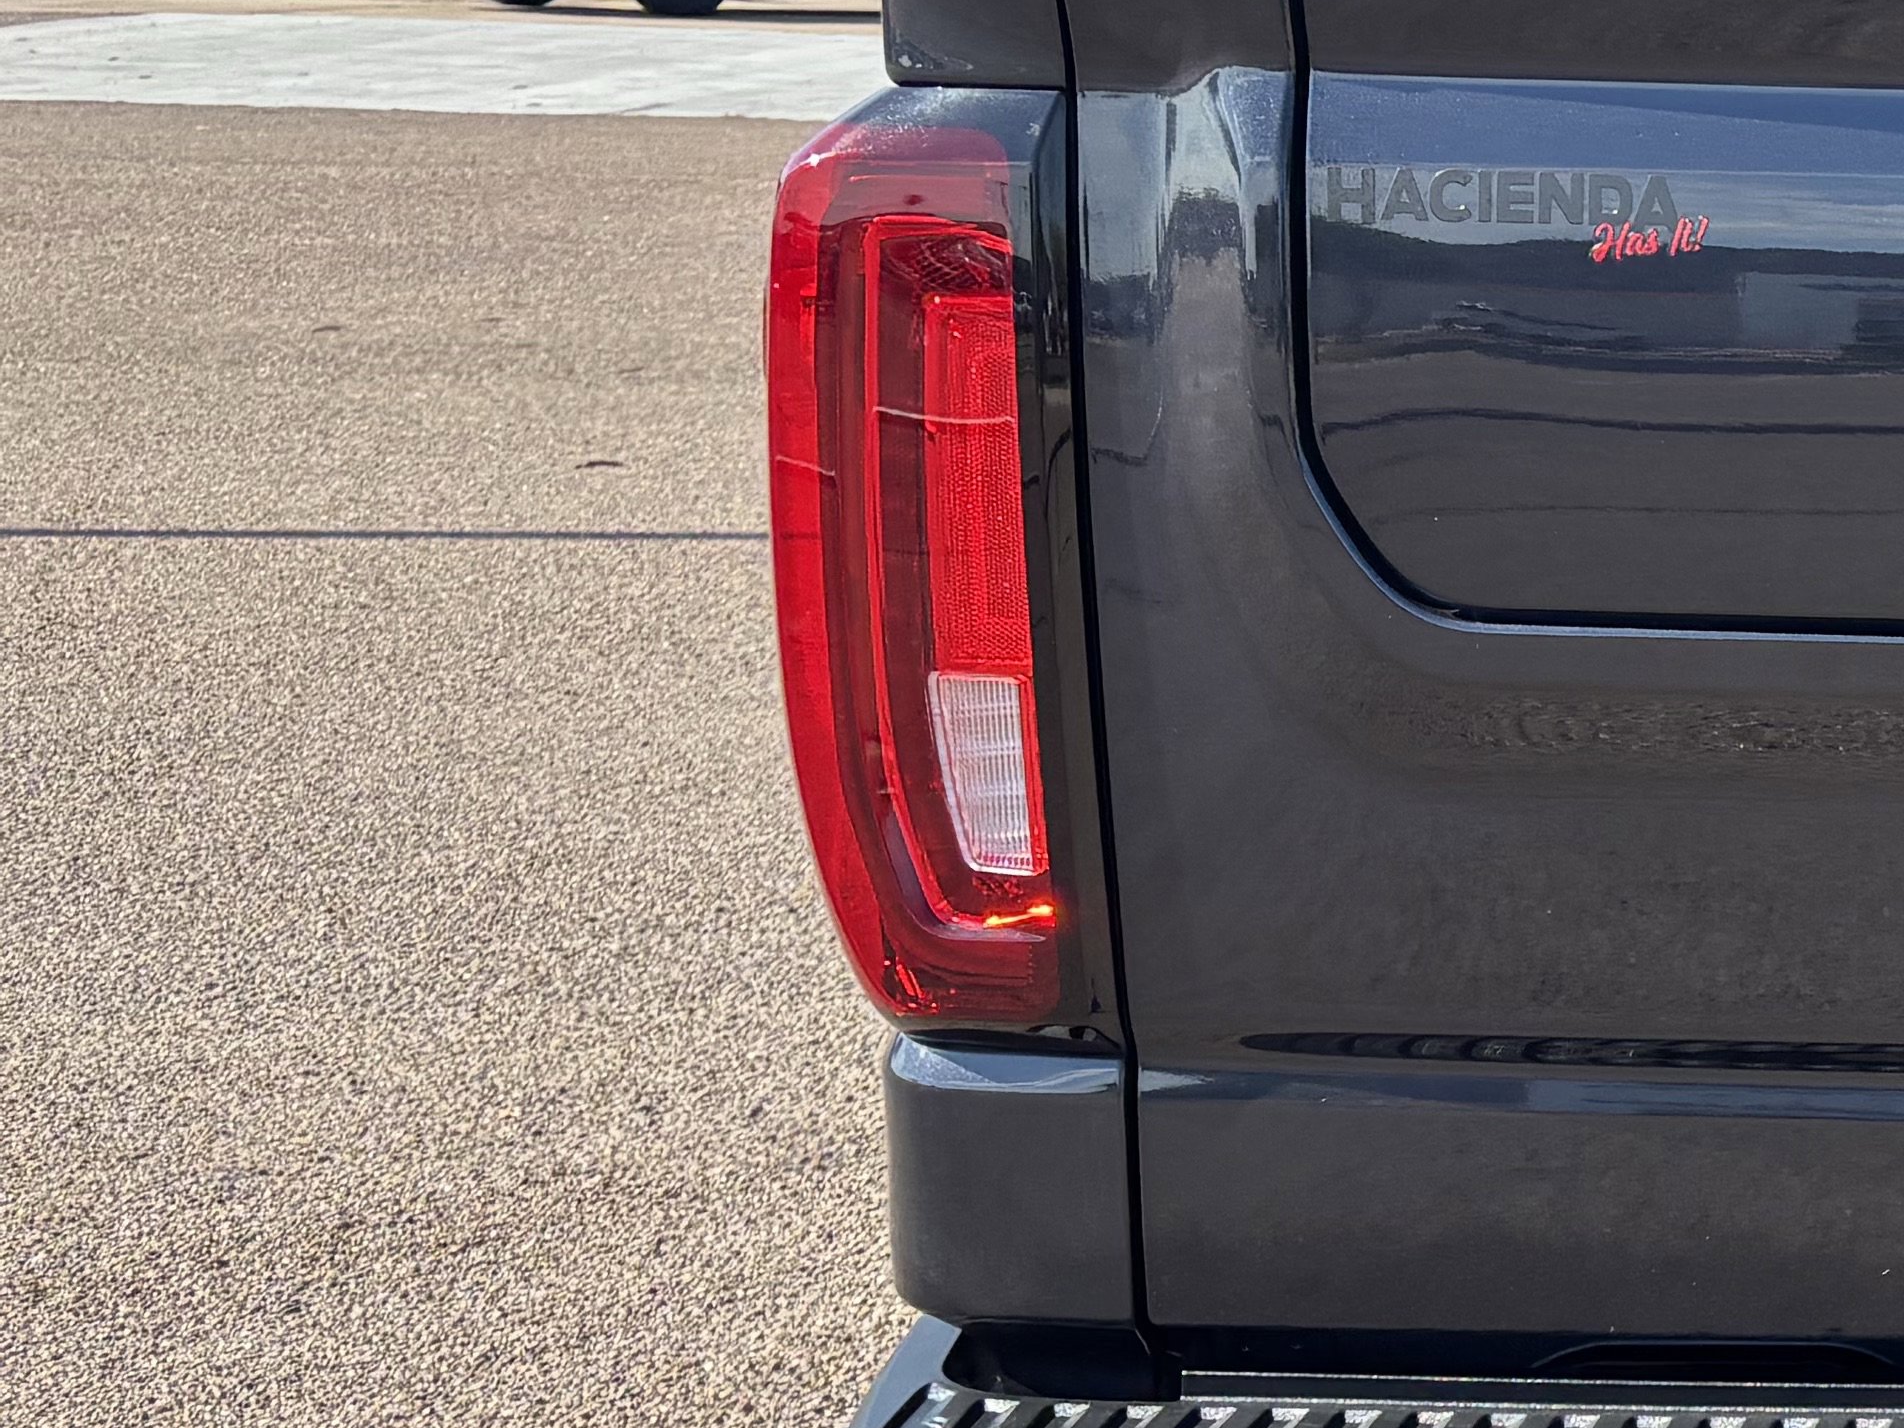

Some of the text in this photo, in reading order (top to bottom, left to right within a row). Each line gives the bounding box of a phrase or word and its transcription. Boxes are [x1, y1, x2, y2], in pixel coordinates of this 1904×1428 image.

[1326, 165, 1680, 231] HACIENDA
[1590, 214, 1711, 265] Has It!
